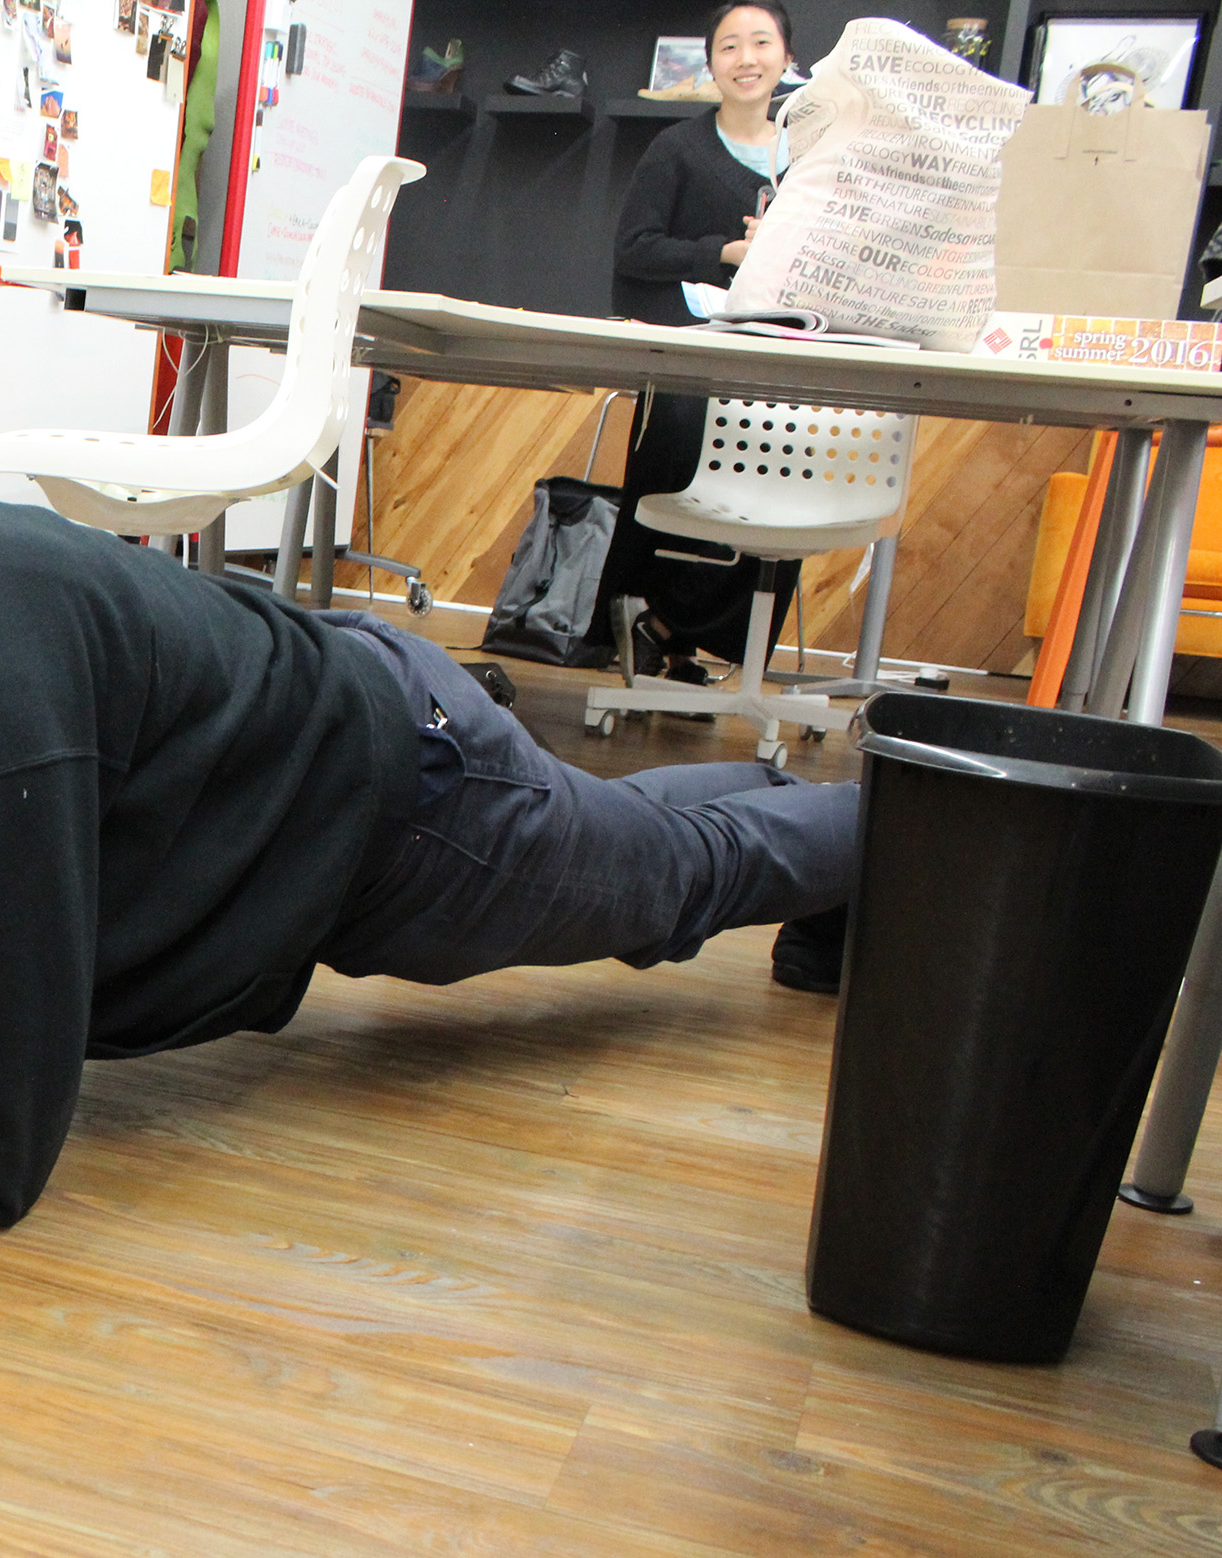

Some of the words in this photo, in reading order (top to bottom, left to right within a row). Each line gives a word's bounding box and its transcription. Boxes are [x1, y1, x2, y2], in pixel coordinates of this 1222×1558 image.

[849, 54, 903, 74] SAVE
[906, 92, 947, 112] OUR
[910, 152, 954, 172] WAY
[836, 171, 887, 192] EARTH
[823, 200, 872, 222] SAVE
[858, 245, 901, 272] OUR
[788, 258, 856, 292] PLANET
[907, 295, 948, 312] save
[776, 289, 798, 308] IS
[1073, 330, 1127, 350] spring
[1054, 346, 1125, 362] summer
[1128, 337, 1210, 367] 2016
